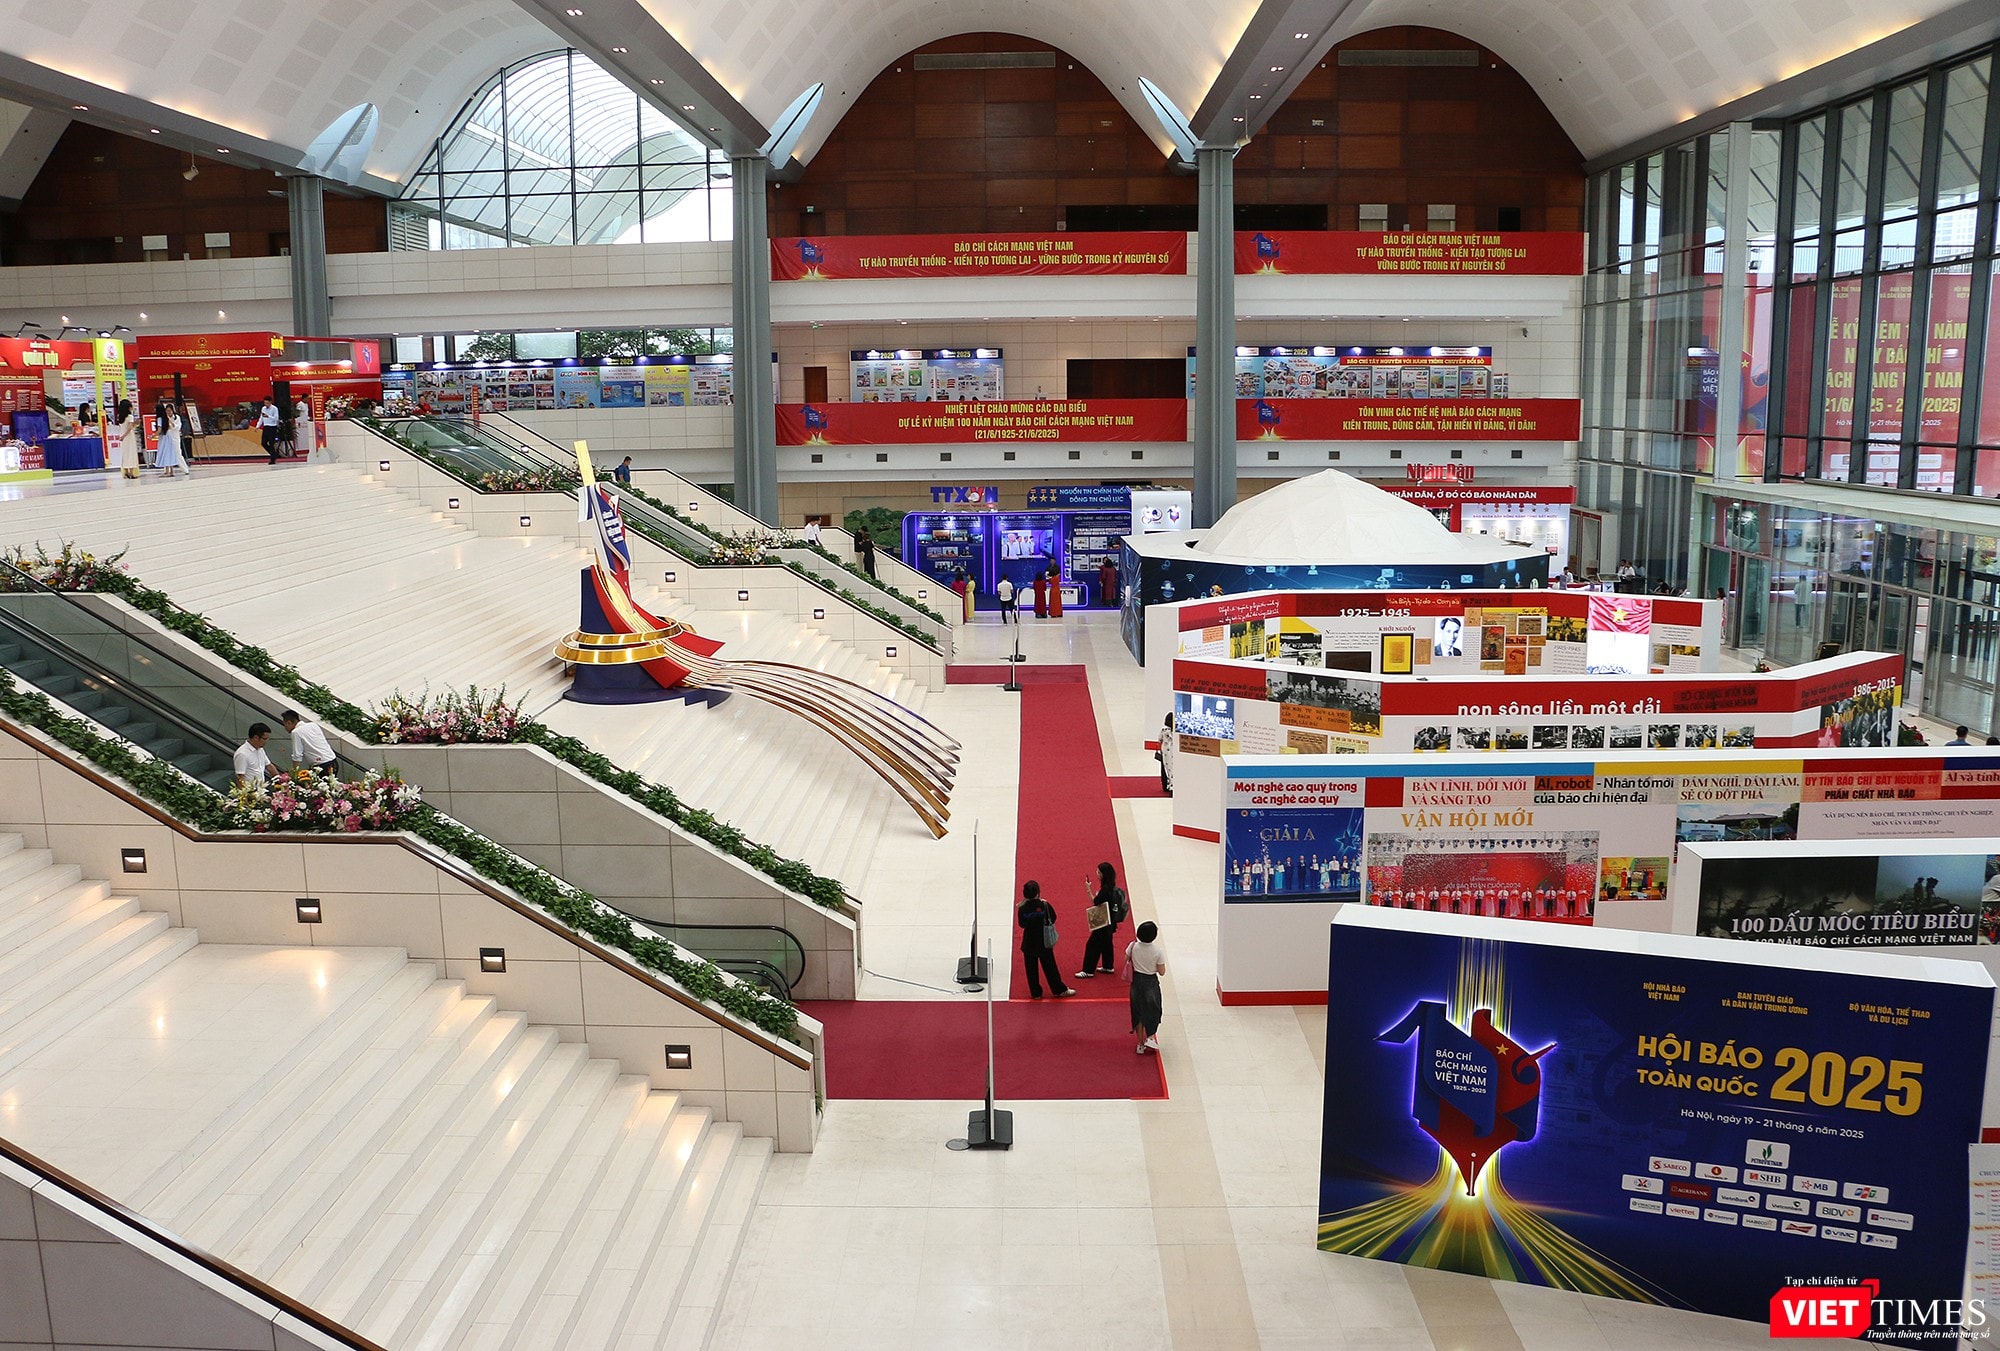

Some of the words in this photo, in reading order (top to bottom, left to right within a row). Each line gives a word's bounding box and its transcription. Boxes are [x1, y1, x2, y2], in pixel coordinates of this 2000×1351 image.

[954, 241, 970, 252] BÁO
[972, 240, 985, 251] CHÍ
[988, 240, 1008, 251] CÁCH
[1010, 242, 1034, 253] MẠNG
[1036, 240, 1052, 252] VIỆT
[1055, 242, 1073, 250] NAM
[945, 403, 967, 415] NHIỆT
[970, 403, 985, 415] LIỆT
[988, 402, 1008, 414] CHÀO
[1010, 402, 1033, 412] MỪNG
[1036, 402, 1051, 412] CÁC
[1054, 404, 1066, 414] ĐẠI
[1069, 400, 1086, 412] BIỂU
[975, 429, 1059, 440] (21/6/1925-21/6/2025)
[1406, 464, 1444, 480] Nhân
[1446, 464, 1475, 480] Dân
[930, 486, 998, 502] TTXVN
[1060, 487, 1082, 495] NGUỒN
[1414, 490, 1435, 499] DÂN,
[1437, 489, 1444, 498] Ở
[1445, 490, 1458, 498] ĐÓ
[1460, 490, 1472, 498] CÓ
[1474, 490, 1492, 498] BÁO
[1493, 490, 1518, 498] NHÂN
[1519, 490, 1536, 498] DÂN
[1458, 705, 1492, 715] non
[1550, 698, 1583, 714] liền
[1632, 697, 1661, 714] dải
[1555, 778, 1590, 789] robot
[1604, 778, 1635, 788] Nhân
[1638, 776, 1651, 788] tố
[1652, 777, 1674, 788] mới
[1412, 793, 1427, 805] VÀ
[1430, 793, 1463, 805] SÁNG
[1466, 795, 1491, 806] TẠO
[1534, 792, 1555, 803] của
[1558, 792, 1580, 803] báo
[1582, 792, 1600, 803] chí
[1603, 792, 1628, 805] hiện
[1630, 792, 1648, 804] đại
[1401, 809, 1443, 831] VẬN
[1449, 808, 1487, 831] HỘI
[1494, 807, 1534, 826] MỚI
[1260, 824, 1300, 841] GIẢI
[1304, 828, 1315, 840] A
[1732, 918, 1764, 933] 100
[1768, 910, 1812, 932] DẤU
[1817, 909, 1865, 932] MỐC
[1870, 910, 1919, 930] TIÊU
[1923, 906, 1975, 930] BIỂU
[1805, 935, 1826, 945] BÁO
[1830, 934, 1849, 944] CHÍ
[1853, 934, 1881, 944] CÁCH
[1885, 936, 1916, 946] MẠNG
[1920, 933, 1945, 945] VIỆT
[1949, 935, 1972, 943] NAM
[1643, 982, 1655, 991] HỘI
[1656, 984, 1670, 992] NHÀ
[1672, 984, 1686, 993] BÁO
[1648, 991, 1662, 1000] VIỆT
[1664, 993, 1680, 1001] NAM
[1737, 992, 1752, 1000] BAN
[1754, 993, 1775, 1002] TUYÊN
[1777, 995, 1794, 1004] GIÁO
[1732, 1000, 1746, 1008] DÂN
[1748, 1001, 1762, 1011] VẬN
[1764, 1003, 1786, 1012] TRUNG
[1788, 1005, 1808, 1014] ƯƠNG
[1849, 1003, 1859, 1012] BỘ
[1861, 1004, 1875, 1012] VĂN
[1896, 1007, 1910, 1016] THỂ
[1911, 1010, 1930, 1018] THAO
[1869, 1014, 1878, 1022] VÀ
[1892, 1017, 1909, 1026] LỊCH
[1436, 1049, 1454, 1059] BÁO
[1456, 1052, 1472, 1061] CHÍ
[1638, 1033, 1690, 1065] HỘI
[1699, 1040, 1762, 1068] BÁO
[1435, 1060, 1459, 1070] CÁCH
[1461, 1064, 1487, 1074] MẠNG
[1435, 1071, 1459, 1084] VIỆT
[1462, 1075, 1486, 1086] NAM
[1637, 1064, 1691, 1088] TOÀN
[1696, 1075, 1758, 1096] QUỐC
[1770, 1048, 1923, 1116] 2025
[1680, 1108, 1694, 1117] Hà
[1696, 1111, 1714, 1120] Nội,
[1716, 1115, 1741, 1124] ngày
[1743, 1116, 1753, 1124] 19
[1763, 1119, 1772, 1127] 21
[1775, 1121, 1804, 1132] tháng
[1815, 1126, 1837, 1135] năm
[1839, 1129, 1864, 1138] 2025
[1663, 1163, 1687, 1171] SABECO
[1760, 1174, 1781, 1184] SHB
[1813, 1183, 1828, 1191] MB
[1670, 1208, 1695, 1216] viettel
[1822, 1207, 1845, 1217] BIDV
